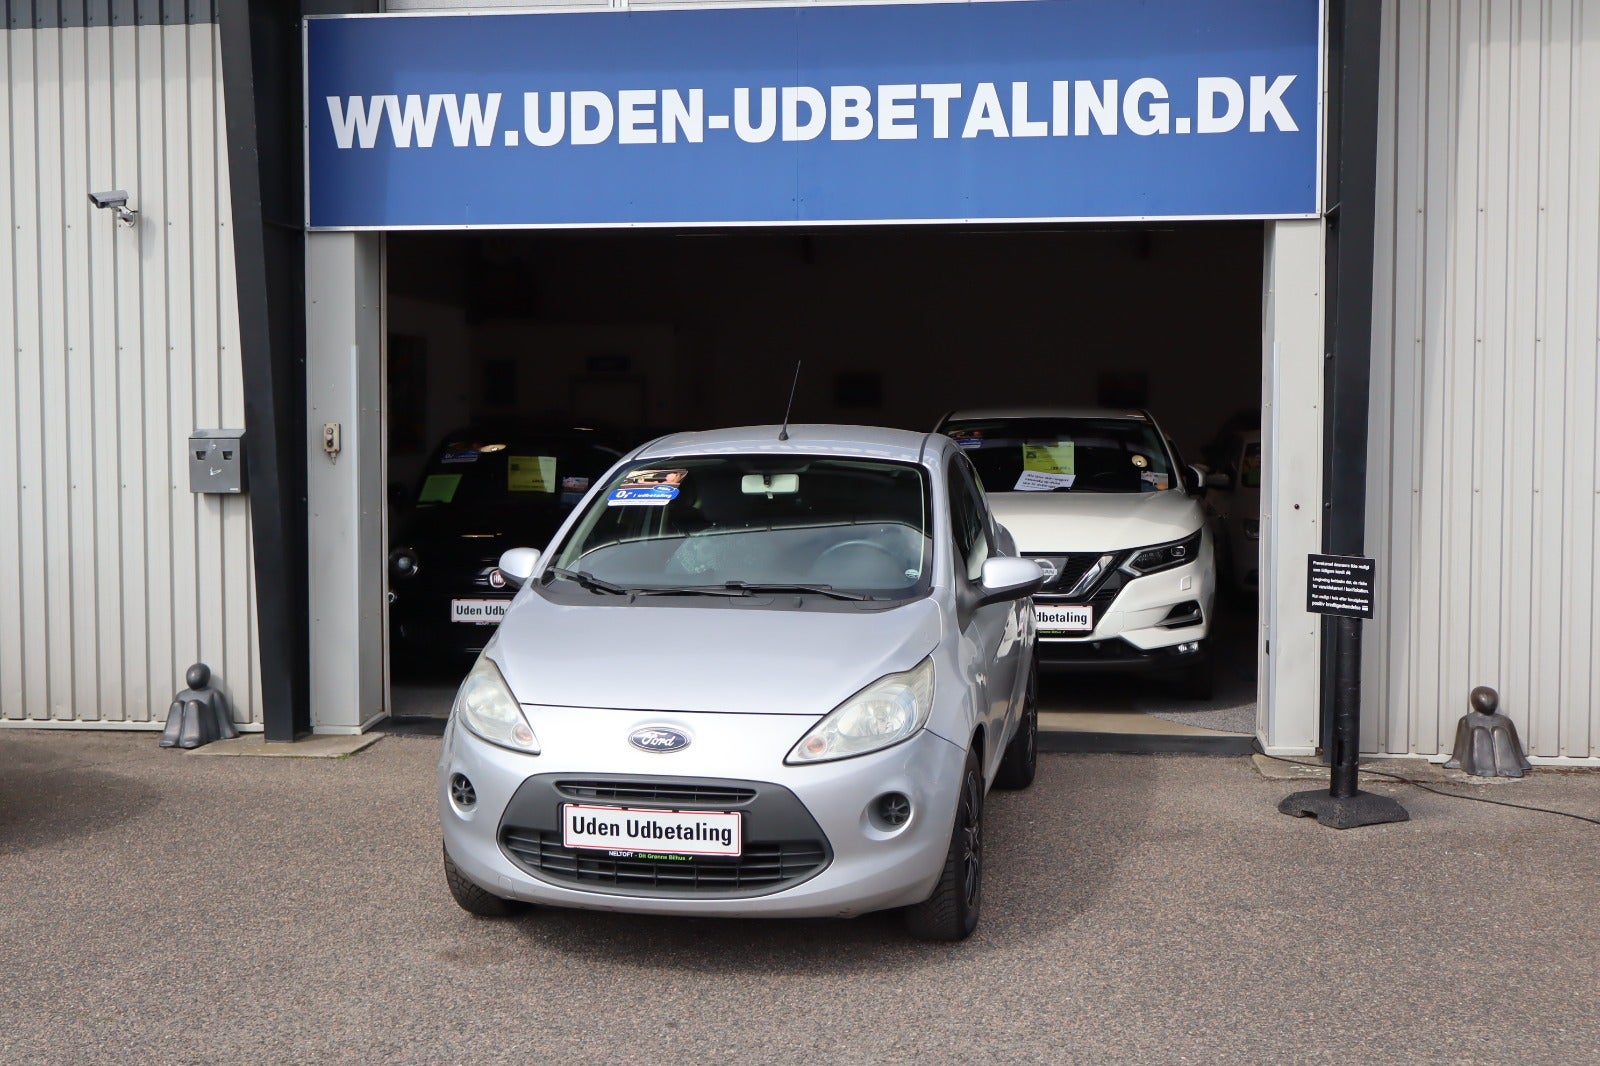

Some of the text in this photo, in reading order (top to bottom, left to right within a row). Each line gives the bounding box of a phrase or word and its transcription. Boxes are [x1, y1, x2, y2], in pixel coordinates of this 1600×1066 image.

[326, 75, 1299, 149] WWW.UDEN-UDBETALING.DK
[456, 605, 506, 616] Uden Udb
[1037, 611, 1087, 625] dbetaling
[641, 731, 676, 746] Ford
[572, 815, 732, 846] Uden Udbetaling
